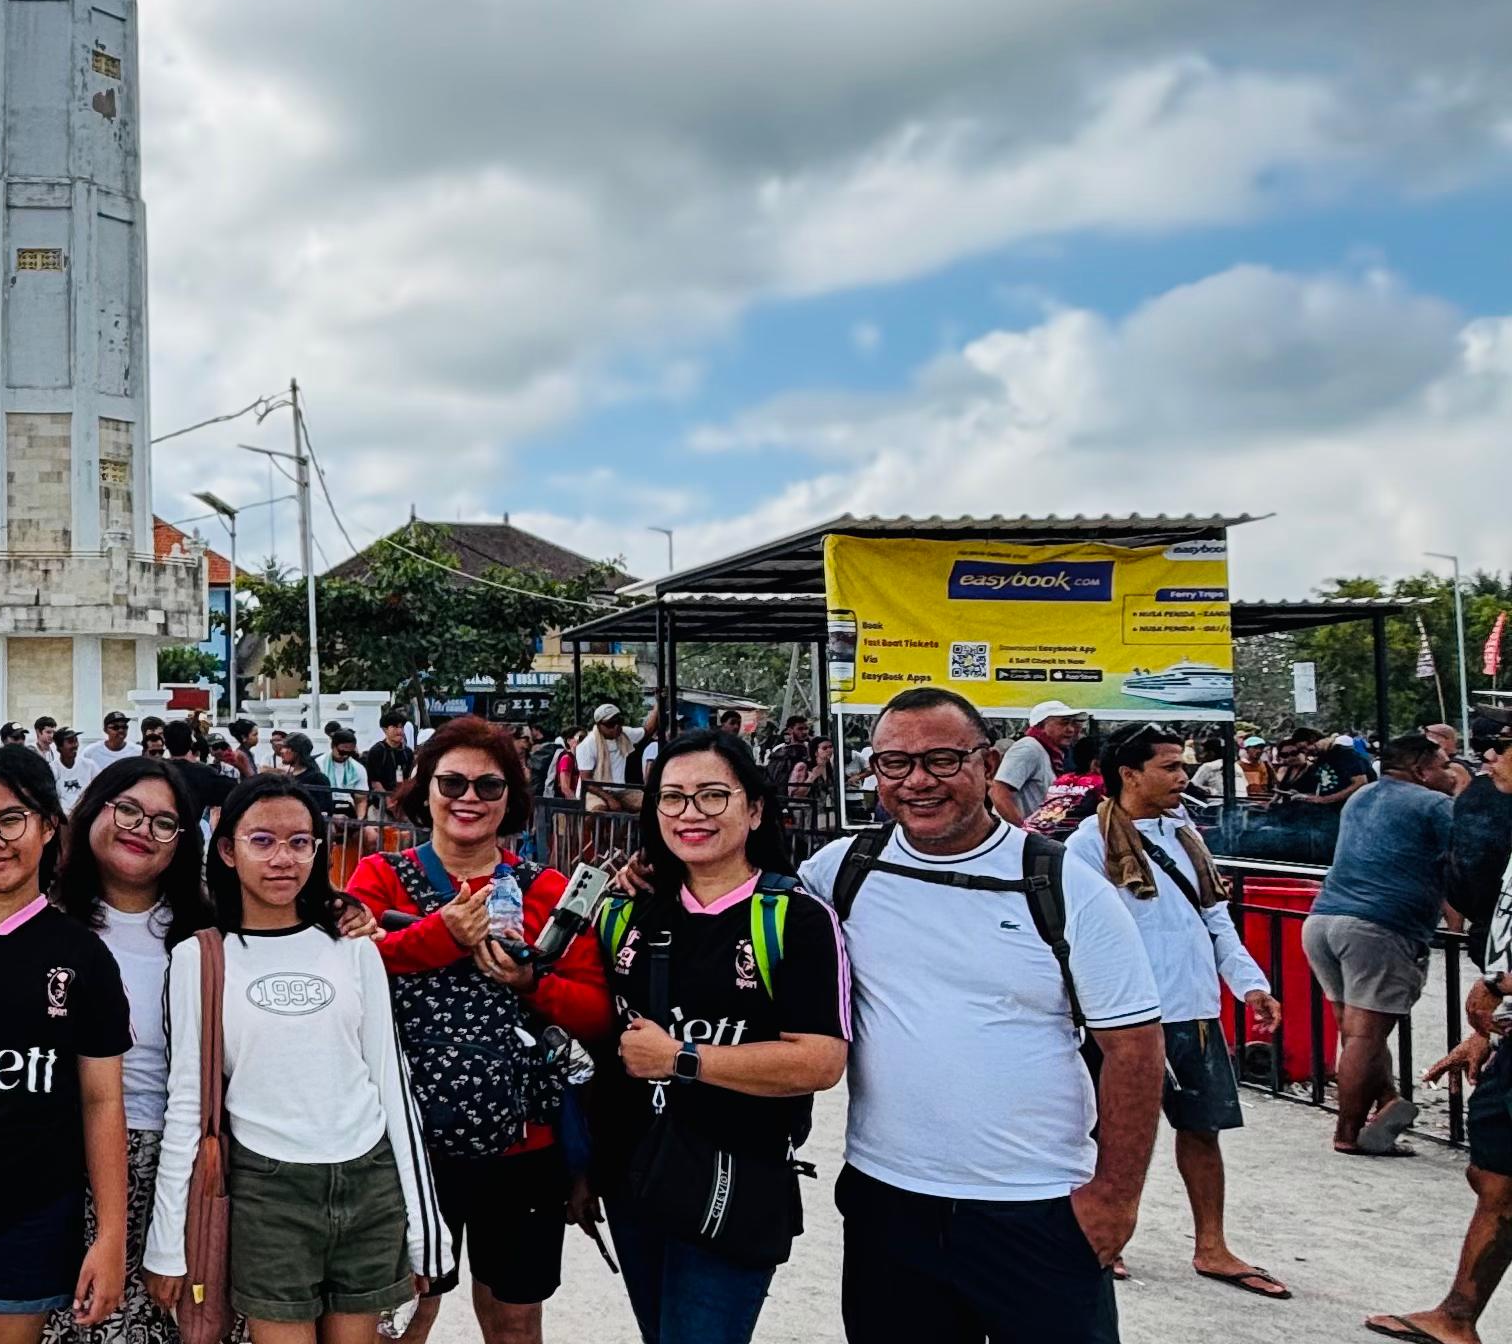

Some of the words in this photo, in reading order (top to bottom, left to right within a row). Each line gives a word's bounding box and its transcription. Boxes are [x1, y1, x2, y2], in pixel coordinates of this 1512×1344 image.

[959, 571, 1071, 591] easybook
[1170, 591, 1197, 599] Ferry
[1199, 591, 1225, 599] Trips
[904, 639, 939, 648] Tickets
[1080, 646, 1096, 654] App
[863, 655, 878, 663] Via
[907, 673, 932, 684] Apps
[256, 978, 327, 1007] 1993
